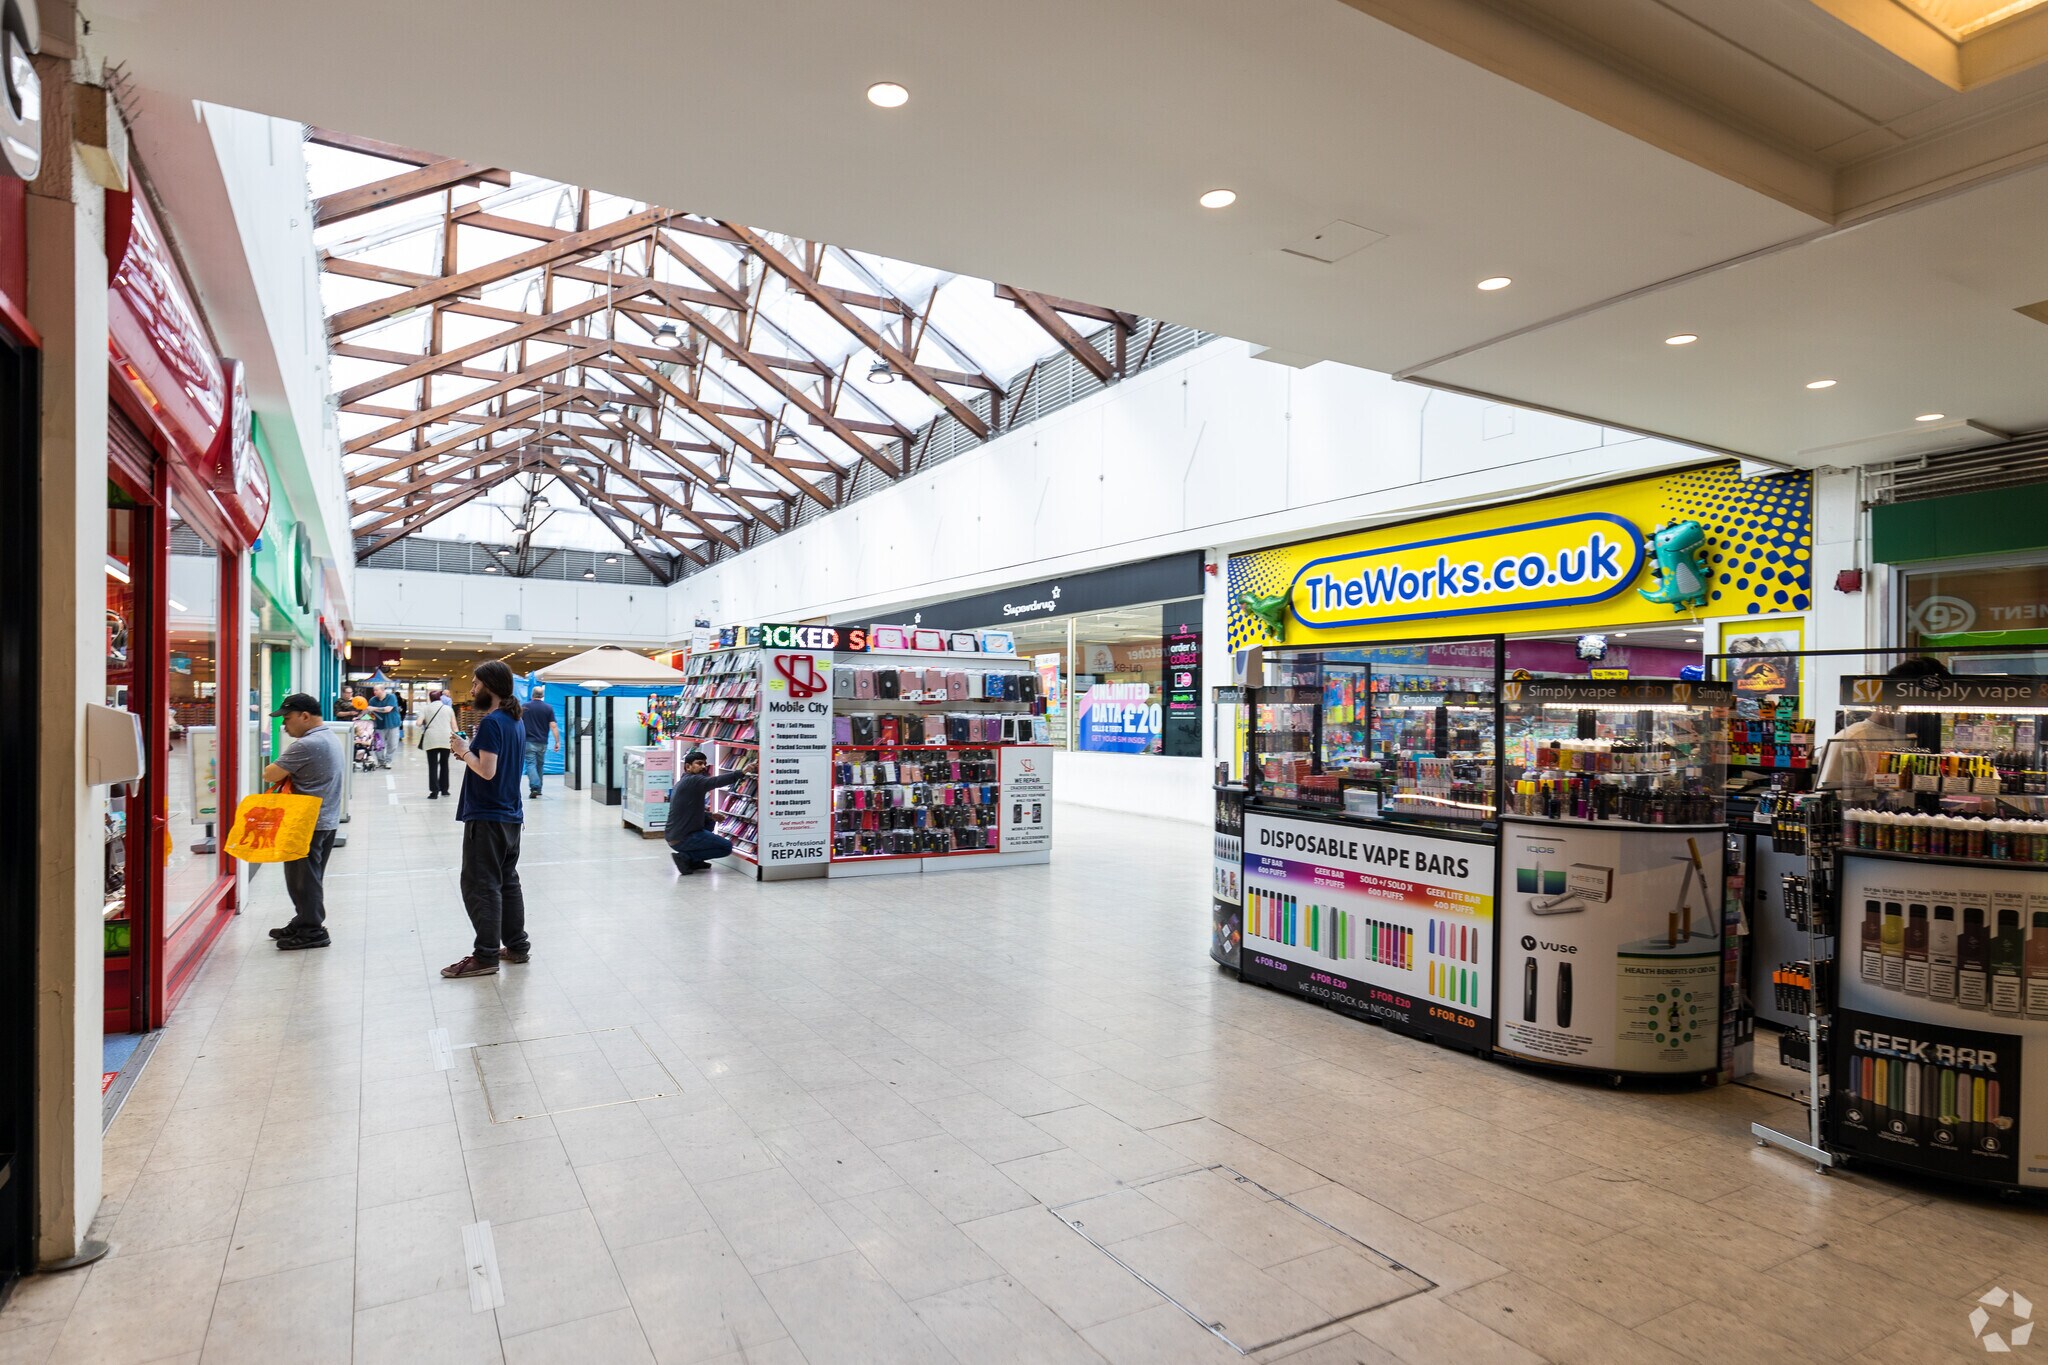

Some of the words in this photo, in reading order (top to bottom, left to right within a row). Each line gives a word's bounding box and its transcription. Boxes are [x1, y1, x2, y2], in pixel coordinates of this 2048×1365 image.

[1304, 533, 1620, 612] TheWorks.co.uk
[1002, 599, 1057, 617] Superdrug
[1170, 642, 1190, 653] order
[1190, 642, 1196, 652] &
[1432, 644, 1446, 655] Art,
[1450, 644, 1470, 656] Craft
[1471, 647, 1478, 656] &
[1170, 653, 1196, 664] collect
[1092, 683, 1150, 700] UNLIMITED
[1219, 690, 1238, 700] Simply
[1528, 686, 1576, 699] Simply
[1579, 688, 1616, 698] vape
[1620, 685, 1628, 698] &
[1634, 686, 1665, 698] CBD
[1698, 686, 1730, 700] Simply
[1977, 685, 2032, 701] vape
[1402, 694, 1426, 705] Simply
[769, 701, 805, 712] Mobile
[808, 702, 828, 716] City
[1092, 703, 1122, 723] DATA
[1123, 703, 1162, 734] £20
[771, 848, 823, 860] REPAIRS
[1260, 828, 1358, 860] DISPOSABLE
[1362, 844, 1410, 868] VAPE
[1415, 852, 1470, 878] BARS
[1261, 857, 1271, 866] ELF
[1272, 858, 1284, 868] BAR
[1258, 866, 1269, 875] 600
[1270, 868, 1287, 878] PUFFS
[1314, 867, 1330, 876] GEEK
[1331, 870, 1344, 879] BAR
[1570, 874, 1604, 885] HEETS
[1313, 877, 1323, 886] 575
[1324, 878, 1345, 889] PUFFS
[1360, 875, 1377, 886] SOLO
[1388, 880, 1405, 890] SOLO
[1407, 883, 1413, 892] X
[1368, 888, 1381, 897] 600
[1382, 889, 1404, 901] PUFFS
[1426, 888, 1445, 899] GEEK
[1447, 890, 1462, 901] LITE
[1464, 894, 1480, 905] BAR
[1434, 901, 1449, 910] 400
[1450, 902, 1475, 914] PUFFS
[1261, 958, 1274, 968] FOR
[1275, 961, 1287, 971] £20
[1310, 972, 1316, 981] 4
[1316, 974, 1331, 985] FOR
[1333, 978, 1347, 990] £20
[1298, 982, 1309, 992] WE
[1311, 984, 1330, 999] ALSO
[1332, 988, 1357, 1007] STOCK
[1370, 1003, 1410, 1023] NICOTINE
[1370, 990, 1376, 999] 5
[1377, 991, 1393, 1004] FOR
[1395, 996, 1411, 1009] £20
[1429, 1007, 1436, 1016] 6
[1437, 1009, 1455, 1022] FOR
[1458, 1014, 1476, 1028] £20
[1854, 1028, 1931, 1063] GEEK
[1935, 1044, 1998, 1072] BAR
